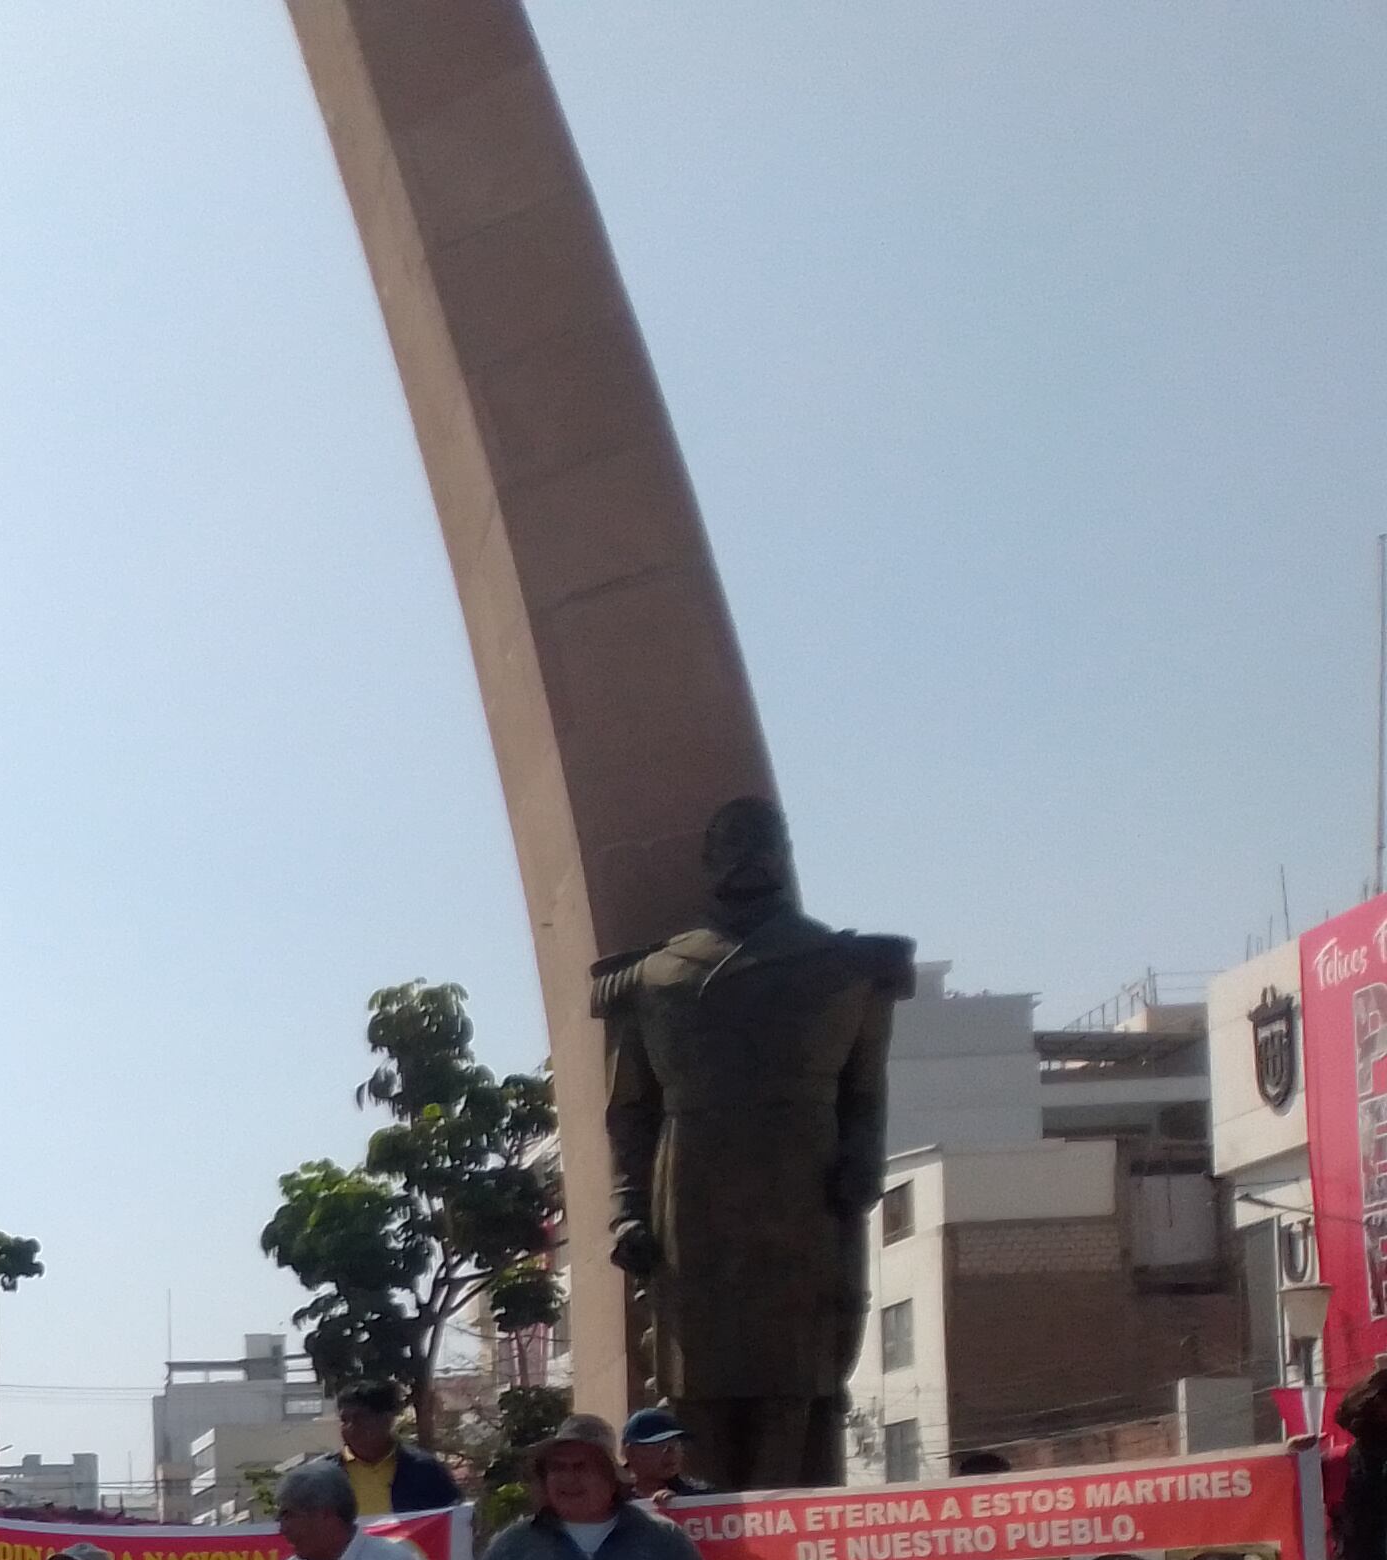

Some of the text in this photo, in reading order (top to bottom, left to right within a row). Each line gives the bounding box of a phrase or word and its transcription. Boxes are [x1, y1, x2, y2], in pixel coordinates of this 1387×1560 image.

[686, 1468, 1253, 1543] GLORIA ETERNA A ESTOS MARTIRES
[1006, 1513, 1145, 1550] PUEBLO.
